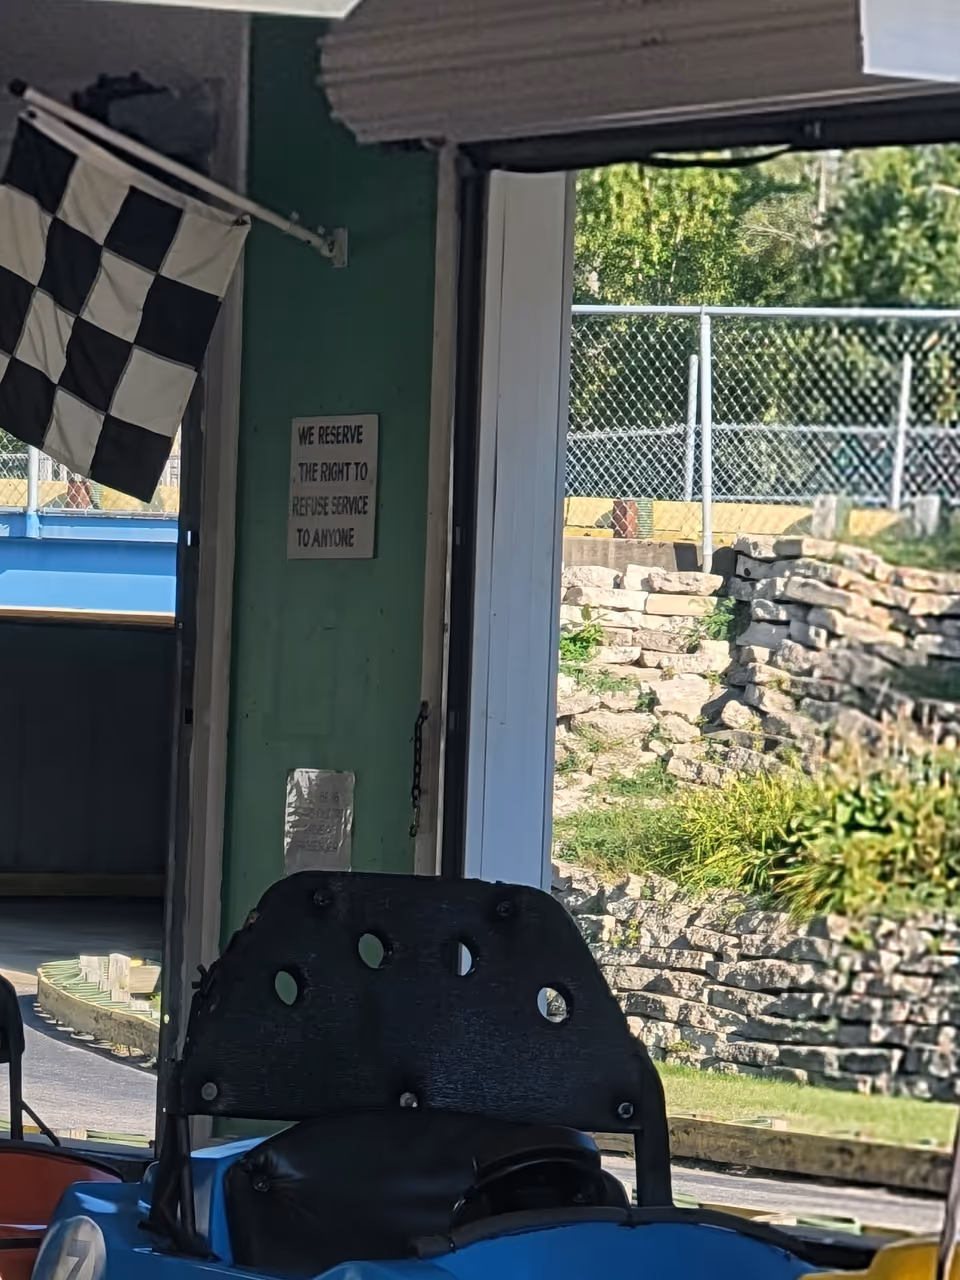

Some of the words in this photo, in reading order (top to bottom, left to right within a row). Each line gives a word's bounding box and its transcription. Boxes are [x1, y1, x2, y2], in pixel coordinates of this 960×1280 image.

[298, 425, 315, 446] WE
[318, 424, 363, 445] RESERVE
[298, 462, 318, 482] THE
[320, 462, 352, 482] RIGHT
[353, 461, 369, 481] TO
[292, 496, 329, 517] REFUSE
[331, 495, 369, 516] SERVICE
[296, 528, 310, 548] TO
[311, 527, 355, 548] ANYONE
